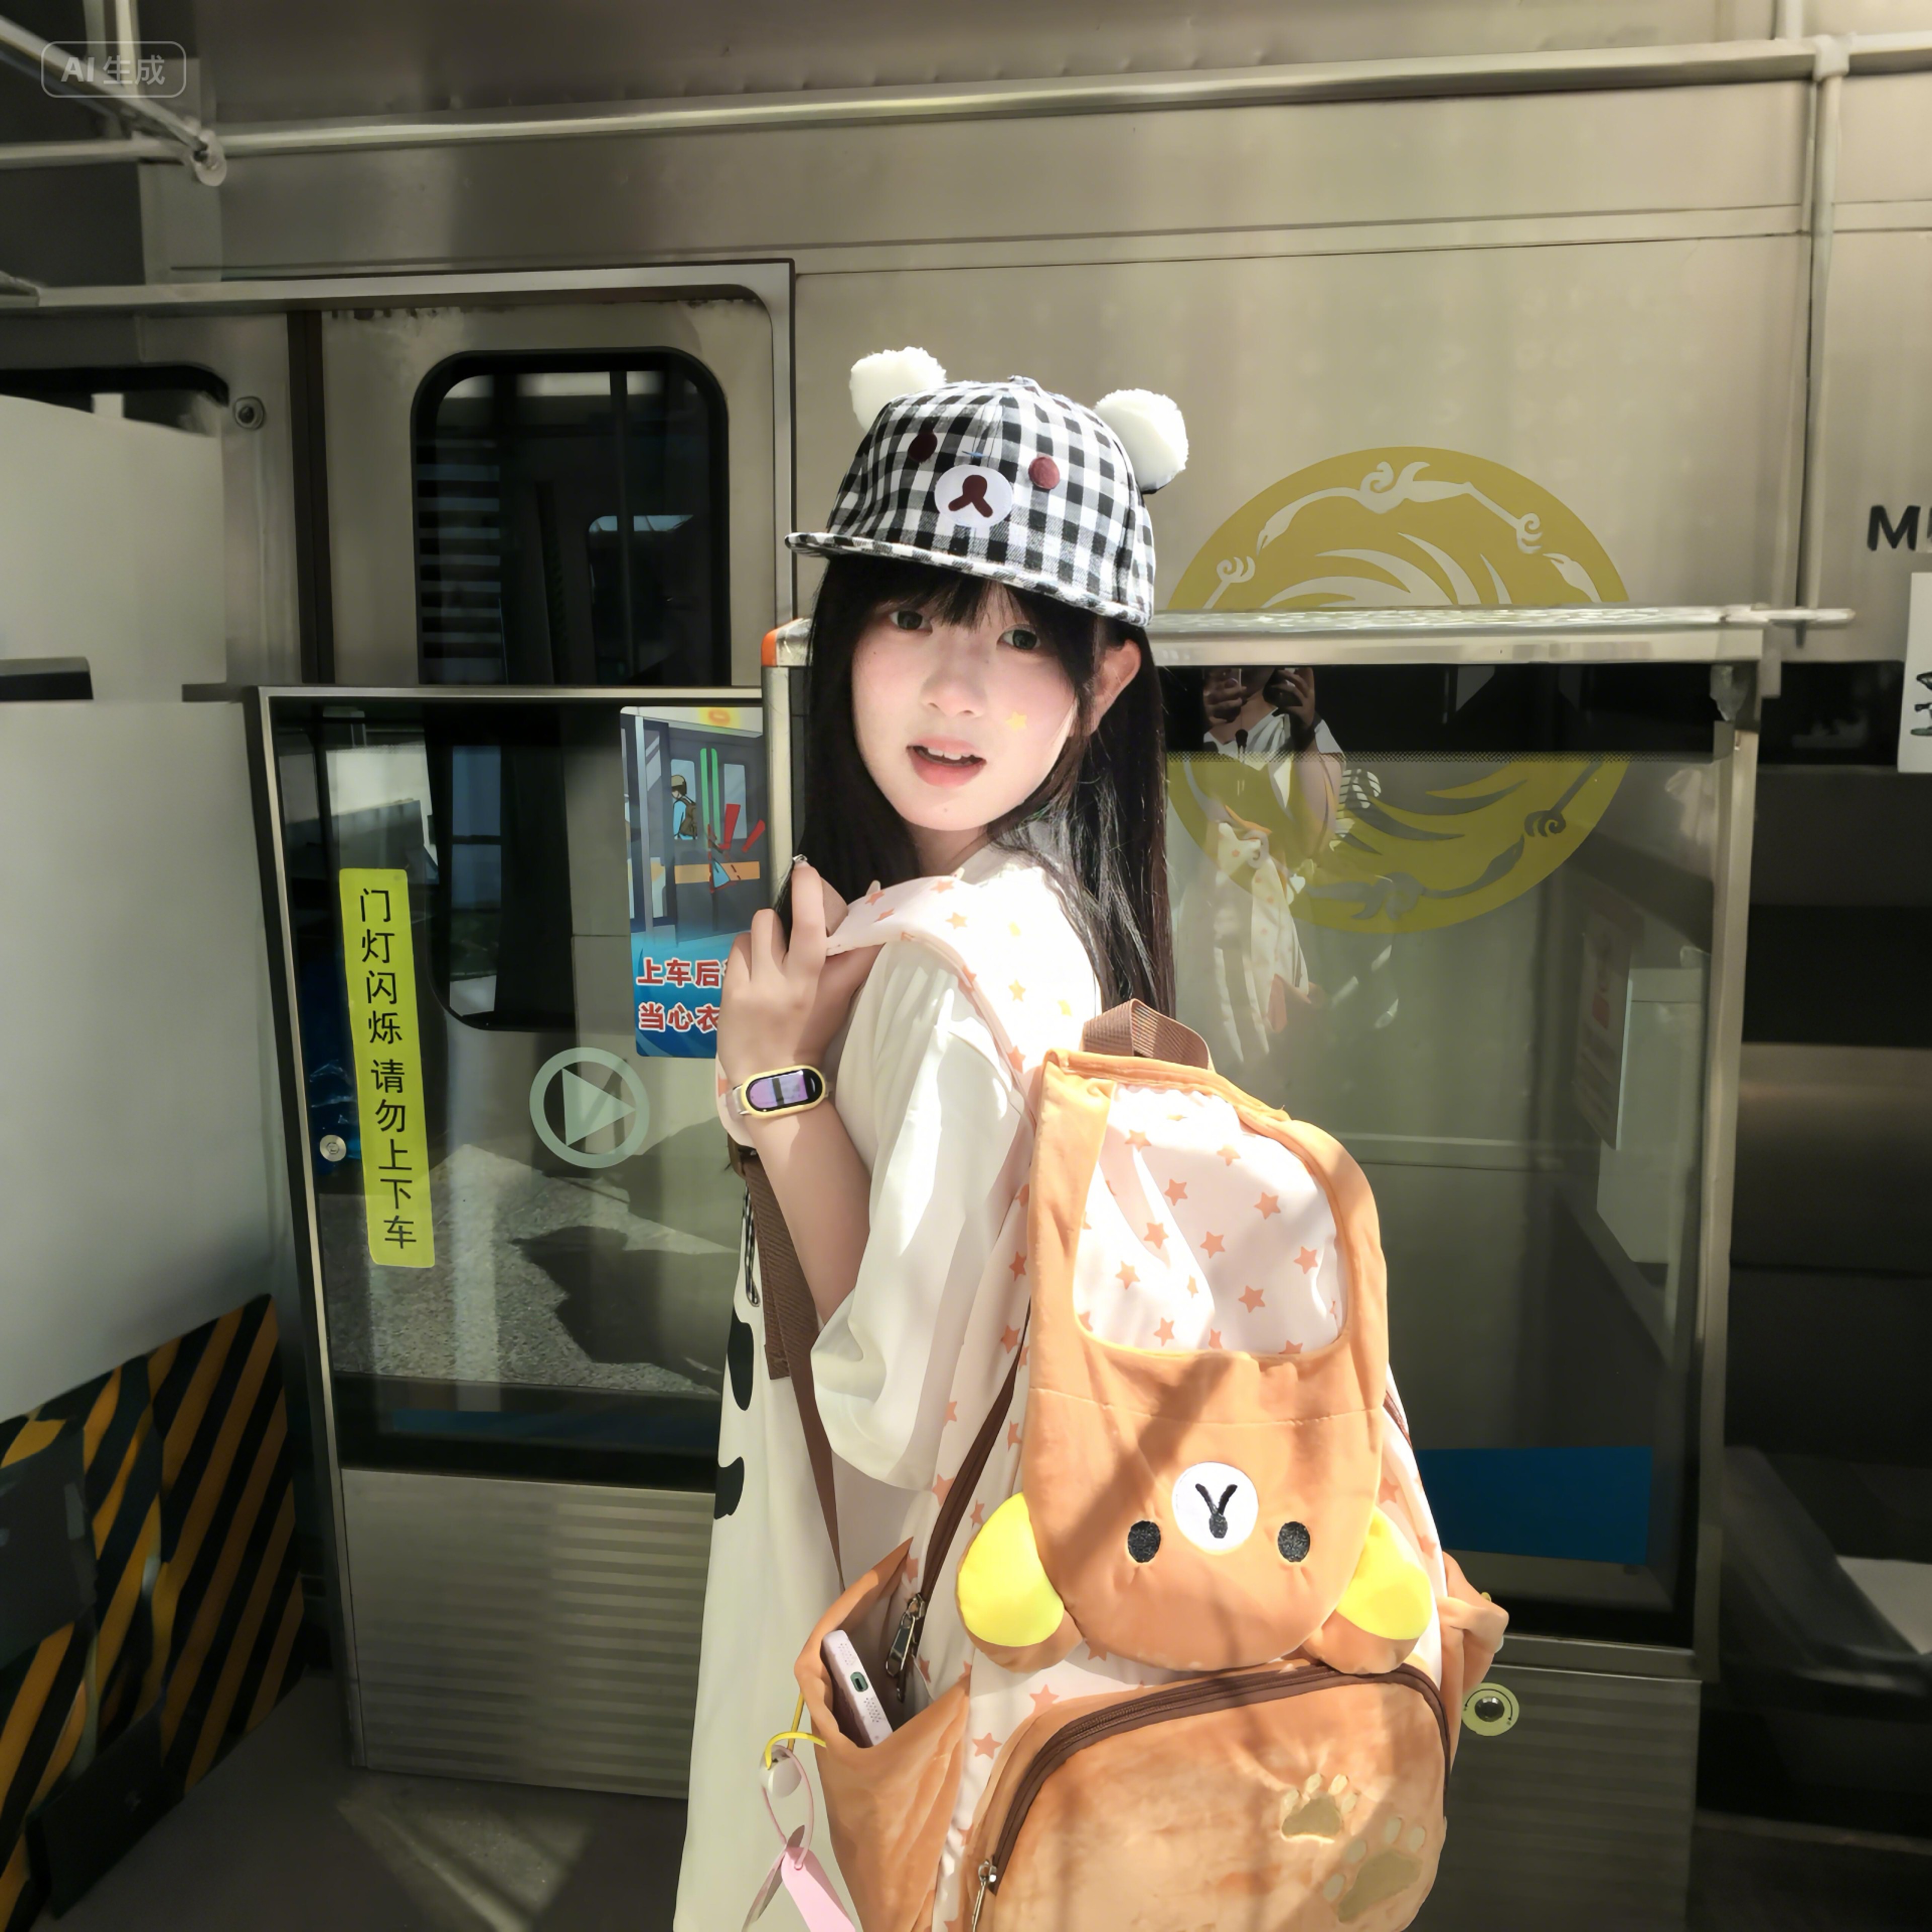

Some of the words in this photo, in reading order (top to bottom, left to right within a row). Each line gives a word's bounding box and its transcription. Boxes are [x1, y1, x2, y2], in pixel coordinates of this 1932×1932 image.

[1867, 505, 1932, 551] M
[360, 888, 403, 1044] 门灯闪烁
[636, 957, 728, 989] 上车后
[370, 1059, 417, 1249] 请勿上下车
